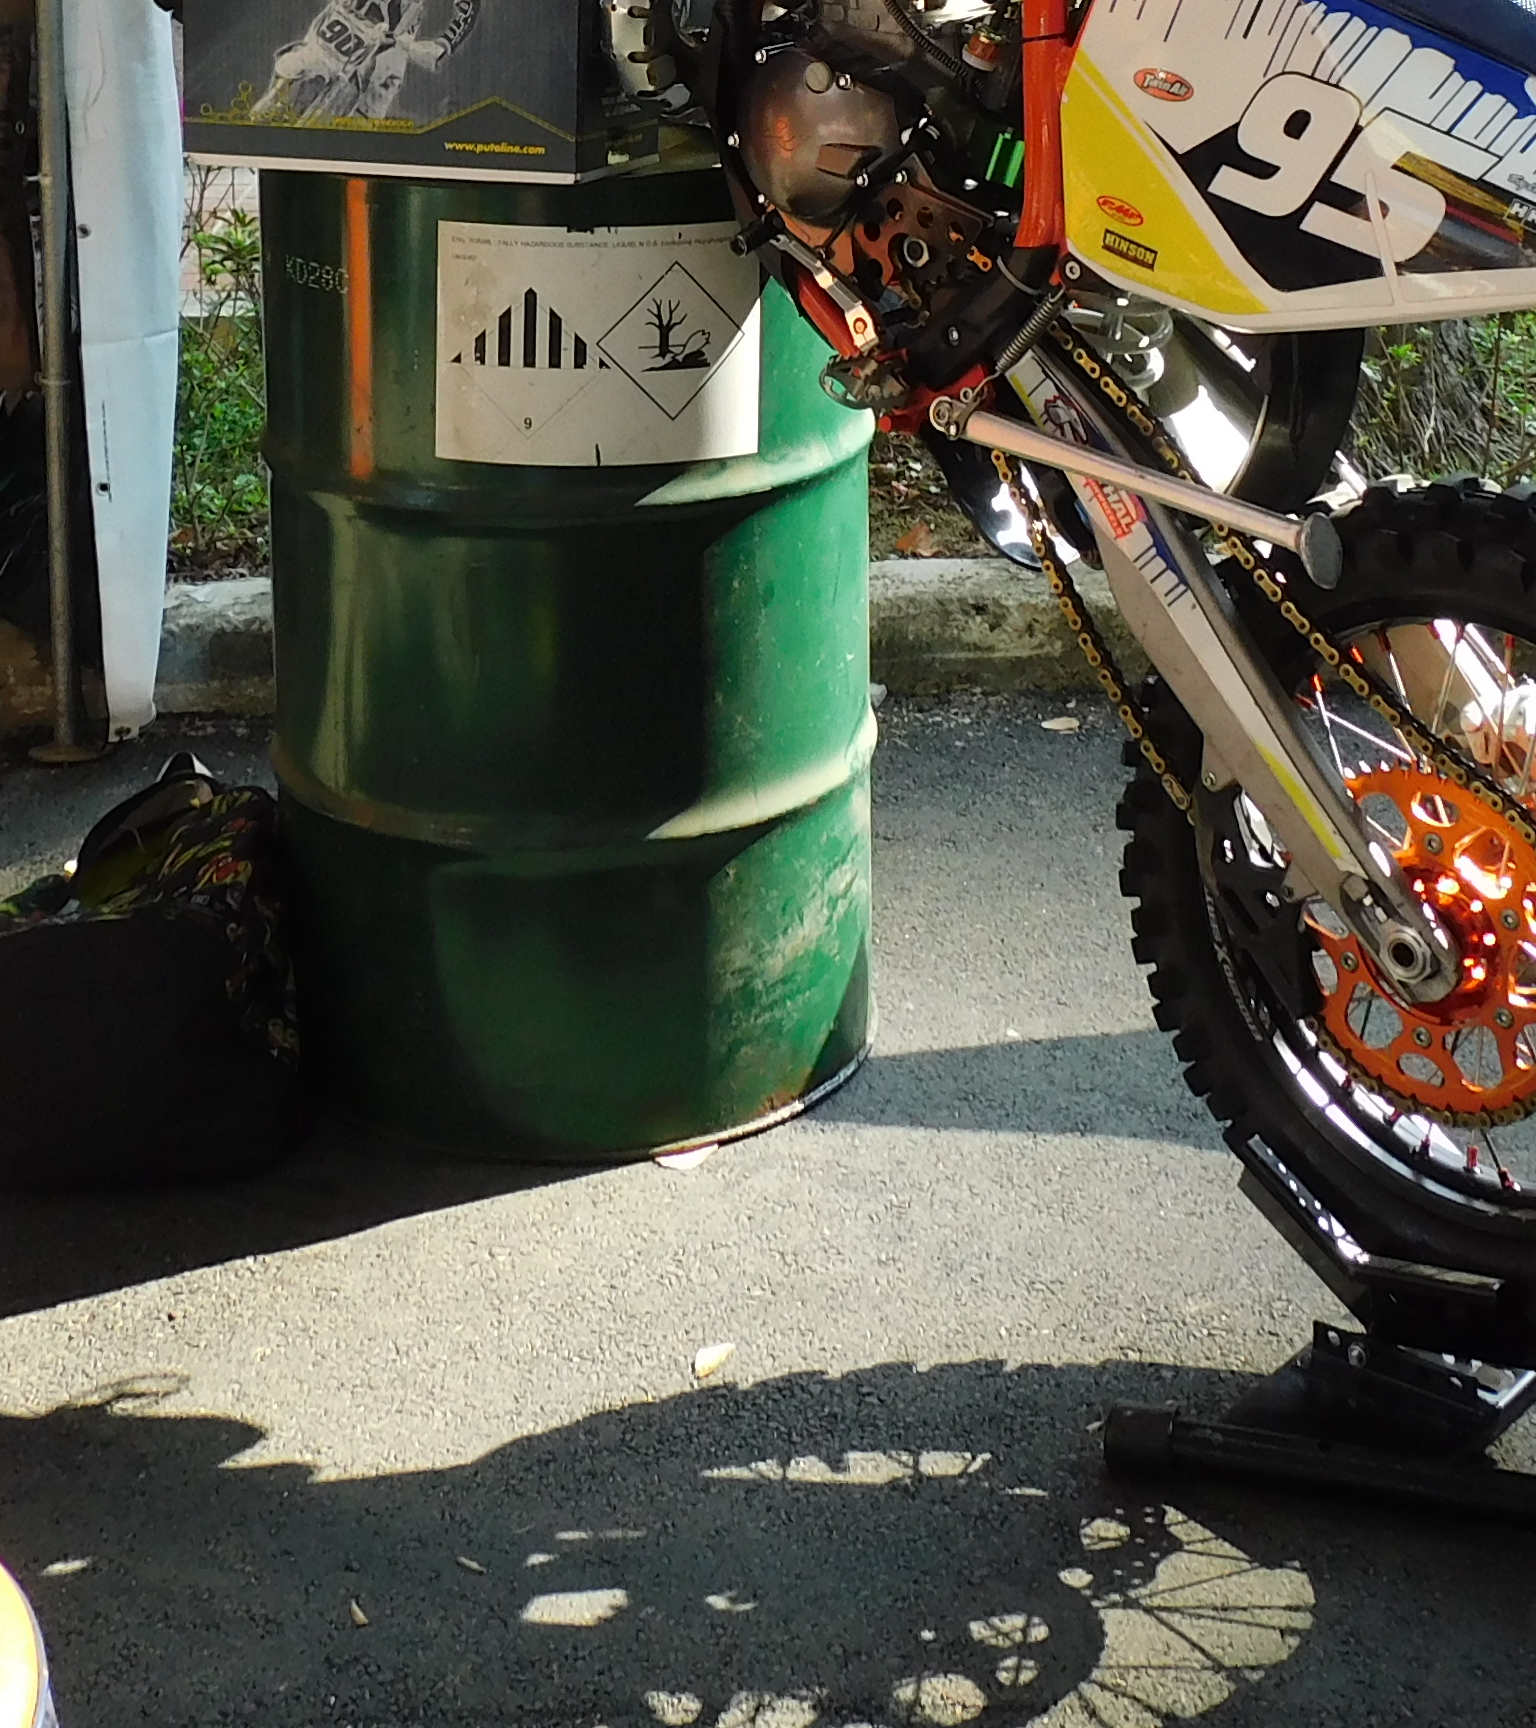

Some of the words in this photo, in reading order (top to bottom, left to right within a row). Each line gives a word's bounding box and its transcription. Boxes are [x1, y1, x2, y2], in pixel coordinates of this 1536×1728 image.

[444, 140, 546, 156] www.putoline.com
[1207, 70, 1503, 263] 95
[1103, 231, 1157, 266] HINSON
[523, 415, 533, 430] 9
